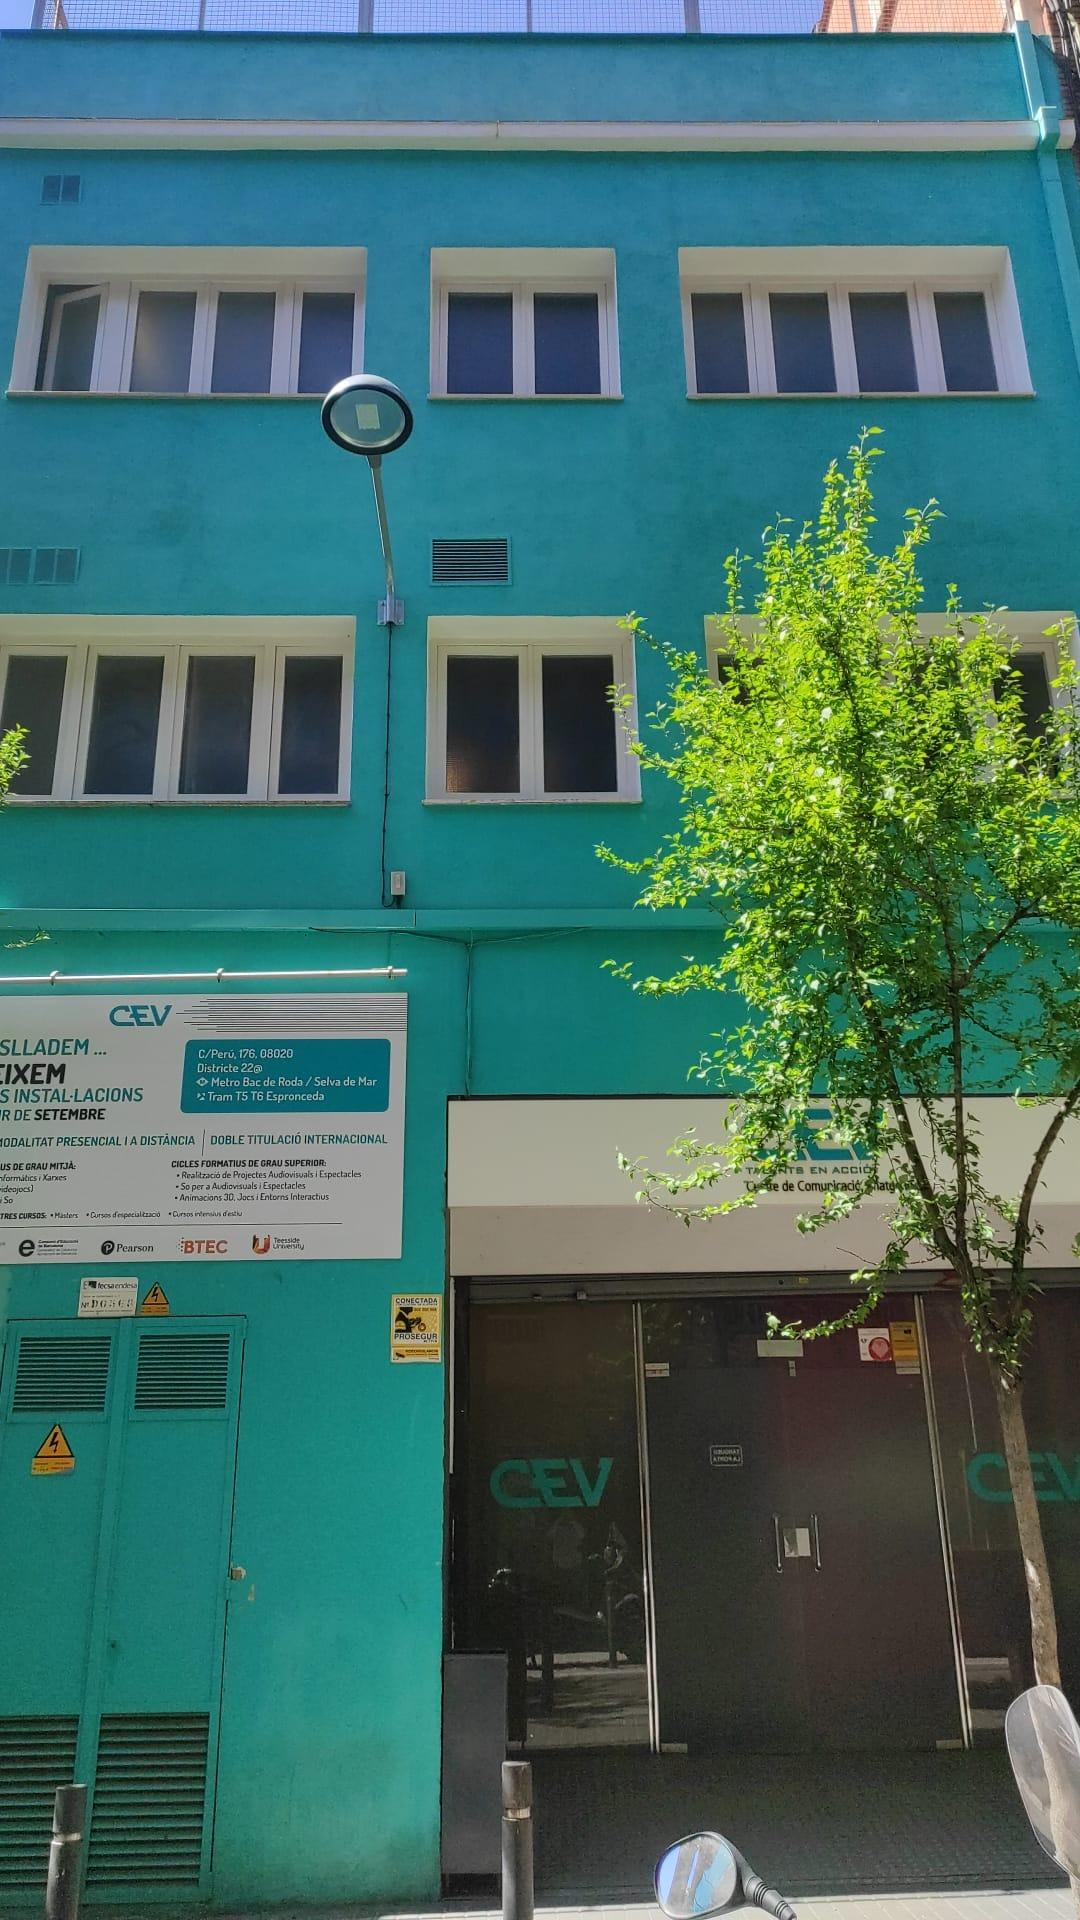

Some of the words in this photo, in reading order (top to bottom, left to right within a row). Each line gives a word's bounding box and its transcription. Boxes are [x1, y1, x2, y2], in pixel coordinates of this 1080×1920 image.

[109, 1005, 173, 1026] CEV
[0, 1038, 89, 1056] SLLADEM
[198, 1049, 237, 1059] C/Perú,
[239, 1049, 258, 1059] 176,
[260, 1049, 293, 1059] 08020
[197, 1063, 239, 1073] Districte
[241, 1064, 263, 1074] 22@
[211, 1077, 240, 1087] Metro
[242, 1077, 261, 1086] Bac
[263, 1076, 276, 1086] de
[278, 1076, 303, 1086] Roda
[314, 1076, 341, 1086] Selva
[343, 1076, 356, 1086] de
[358, 1076, 378, 1086] Mar
[208, 1092, 233, 1101] Tram
[235, 1092, 248, 1101] T5
[251, 1092, 264, 1101] T6
[266, 1091, 325, 1103] Espronceda
[14, 1109, 32, 1121] DE
[34, 1108, 106, 1120] SETEMBRE
[56, 1136, 122, 1146] PRESENCIAL
[129, 1135, 138, 1145] A
[210, 1135, 244, 1145] DOBLE
[247, 1132, 301, 1144] TITULACIÓ
[304, 1134, 388, 1144] INTERNACIONAL
[284, 1159, 327, 1167] SUPERIOR:
[181, 1171, 221, 1179] Realització
[222, 1171, 232, 1179] de
[233, 1171, 267, 1180] Projectes
[268, 1170, 314, 1178] Audiovisuals
[319, 1170, 362, 1179] Espectacles
[810, 1166, 828, 1174] EN
[212, 1182, 258, 1190] Audiovisuals
[263, 1182, 306, 1190] Espectacles
[782, 1180, 795, 1191] de
[179, 1194, 222, 1202] Animacions
[290, 1192, 330, 1200] Interactius
[116, 1243, 154, 1253] Pearson
[183, 1240, 228, 1254] BTEC
[273, 1243, 304, 1251] University
[490, 1457, 614, 1508] CEV
